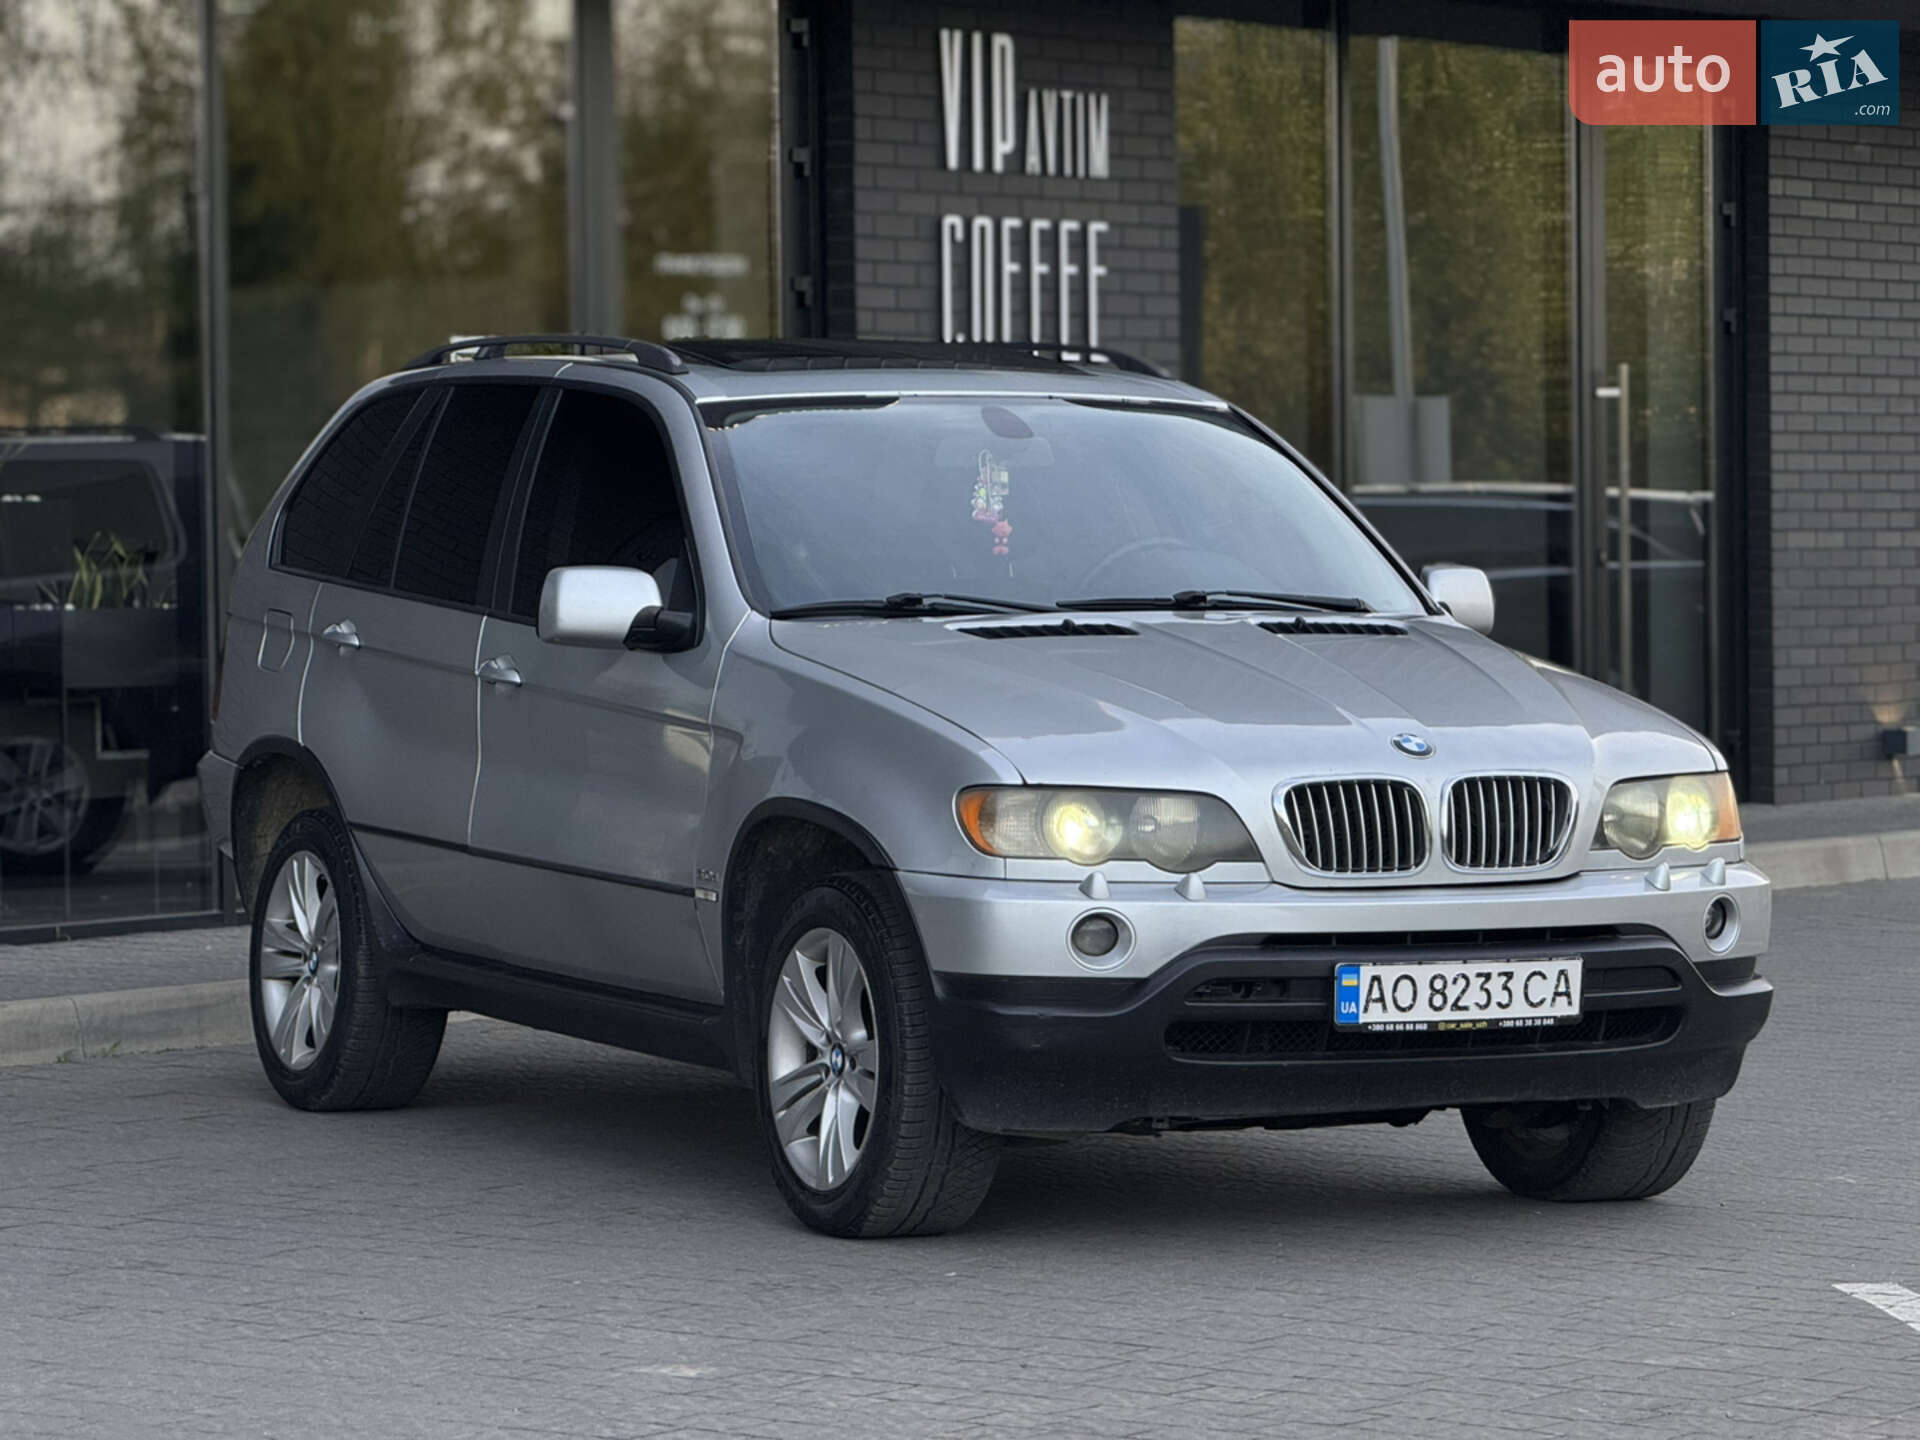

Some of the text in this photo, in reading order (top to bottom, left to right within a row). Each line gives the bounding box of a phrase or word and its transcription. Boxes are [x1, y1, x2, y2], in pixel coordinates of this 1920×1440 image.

[940, 28, 1016, 173] VIP
[942, 214, 1109, 362] COFFEE
[1341, 1001, 1357, 1014] UA
[1362, 968, 1574, 1014] AO 8233 CA
